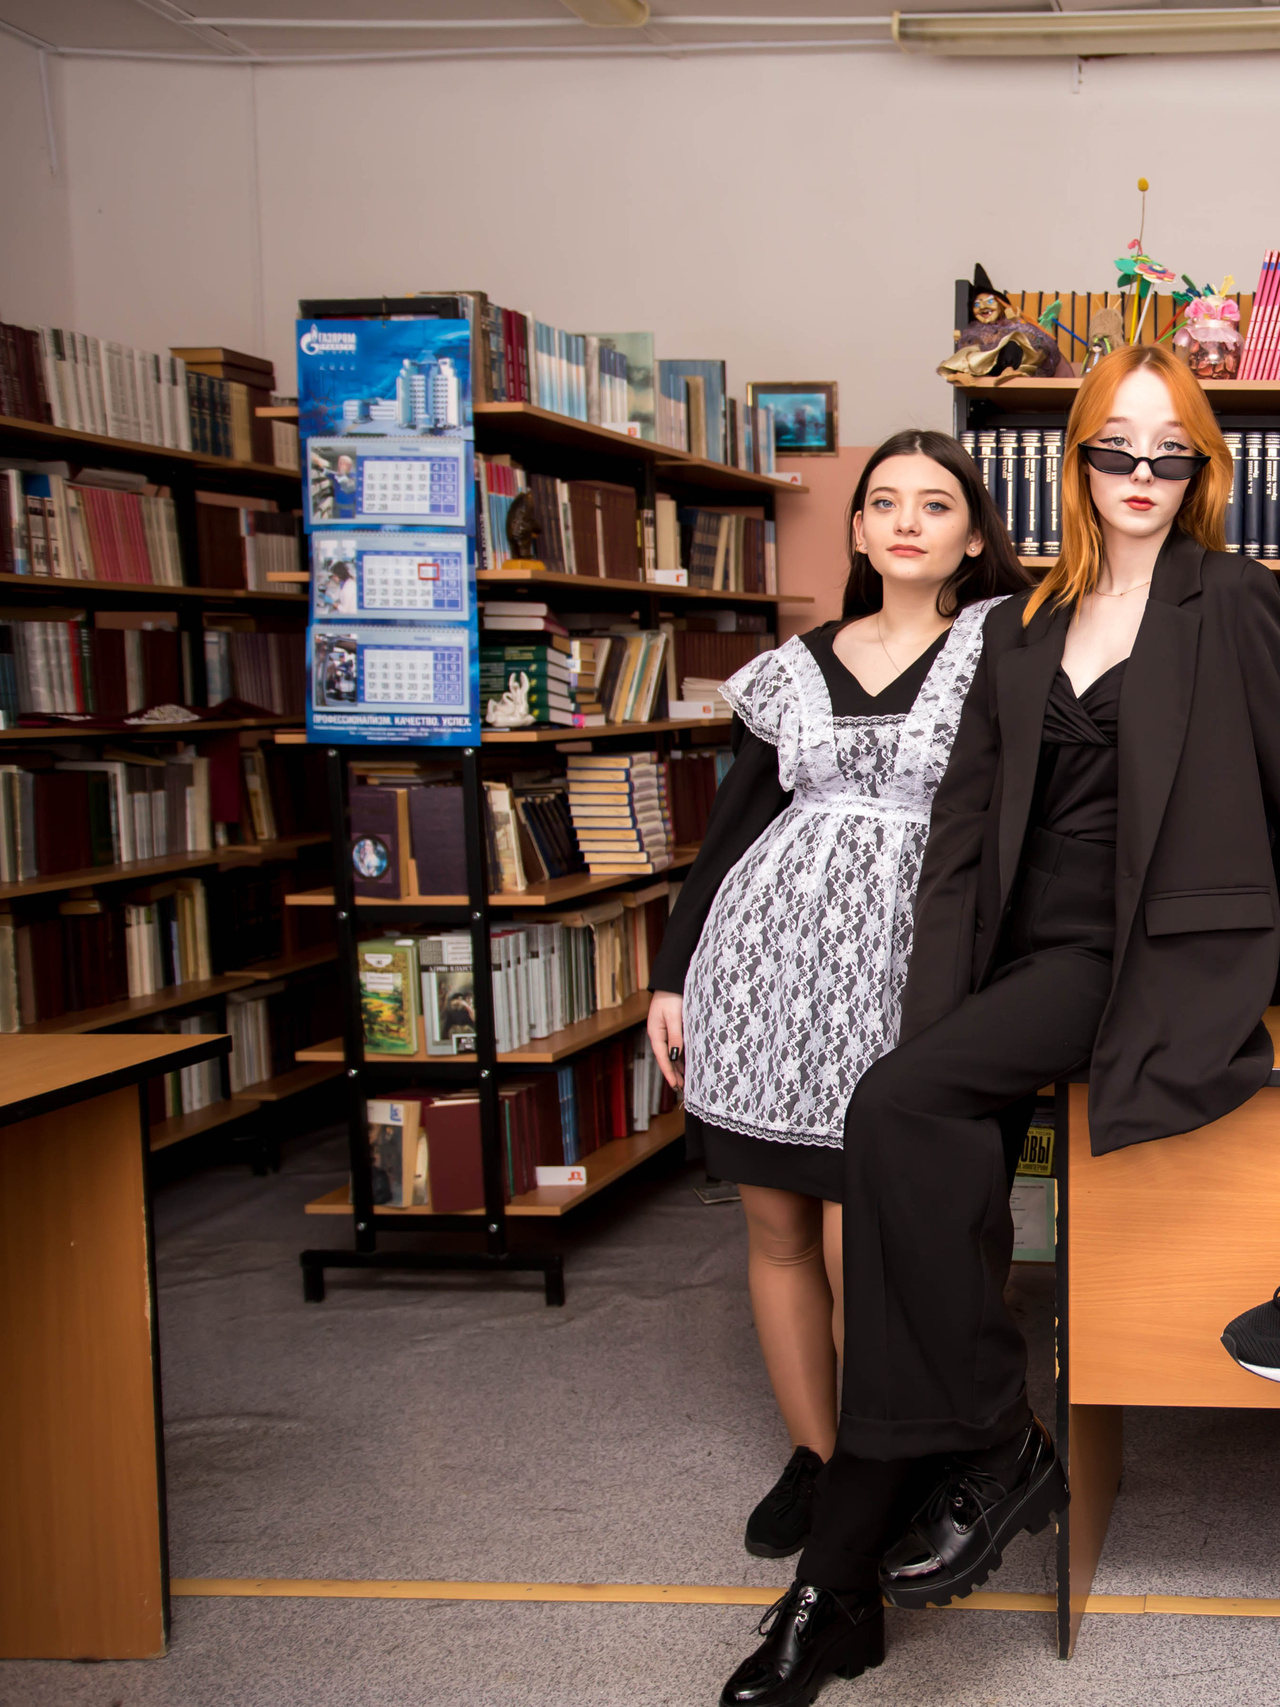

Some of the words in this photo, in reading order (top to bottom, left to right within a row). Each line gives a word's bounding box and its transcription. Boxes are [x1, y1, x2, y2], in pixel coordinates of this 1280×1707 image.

[790, 475, 800, 486] А
[675, 573, 684, 584] Г
[313, 714, 392, 725] ПРОФЕССИОНАЛИЗМ.
[394, 716, 440, 726] КАЧЕСТВО.
[442, 717, 471, 727] УСПЕХ.
